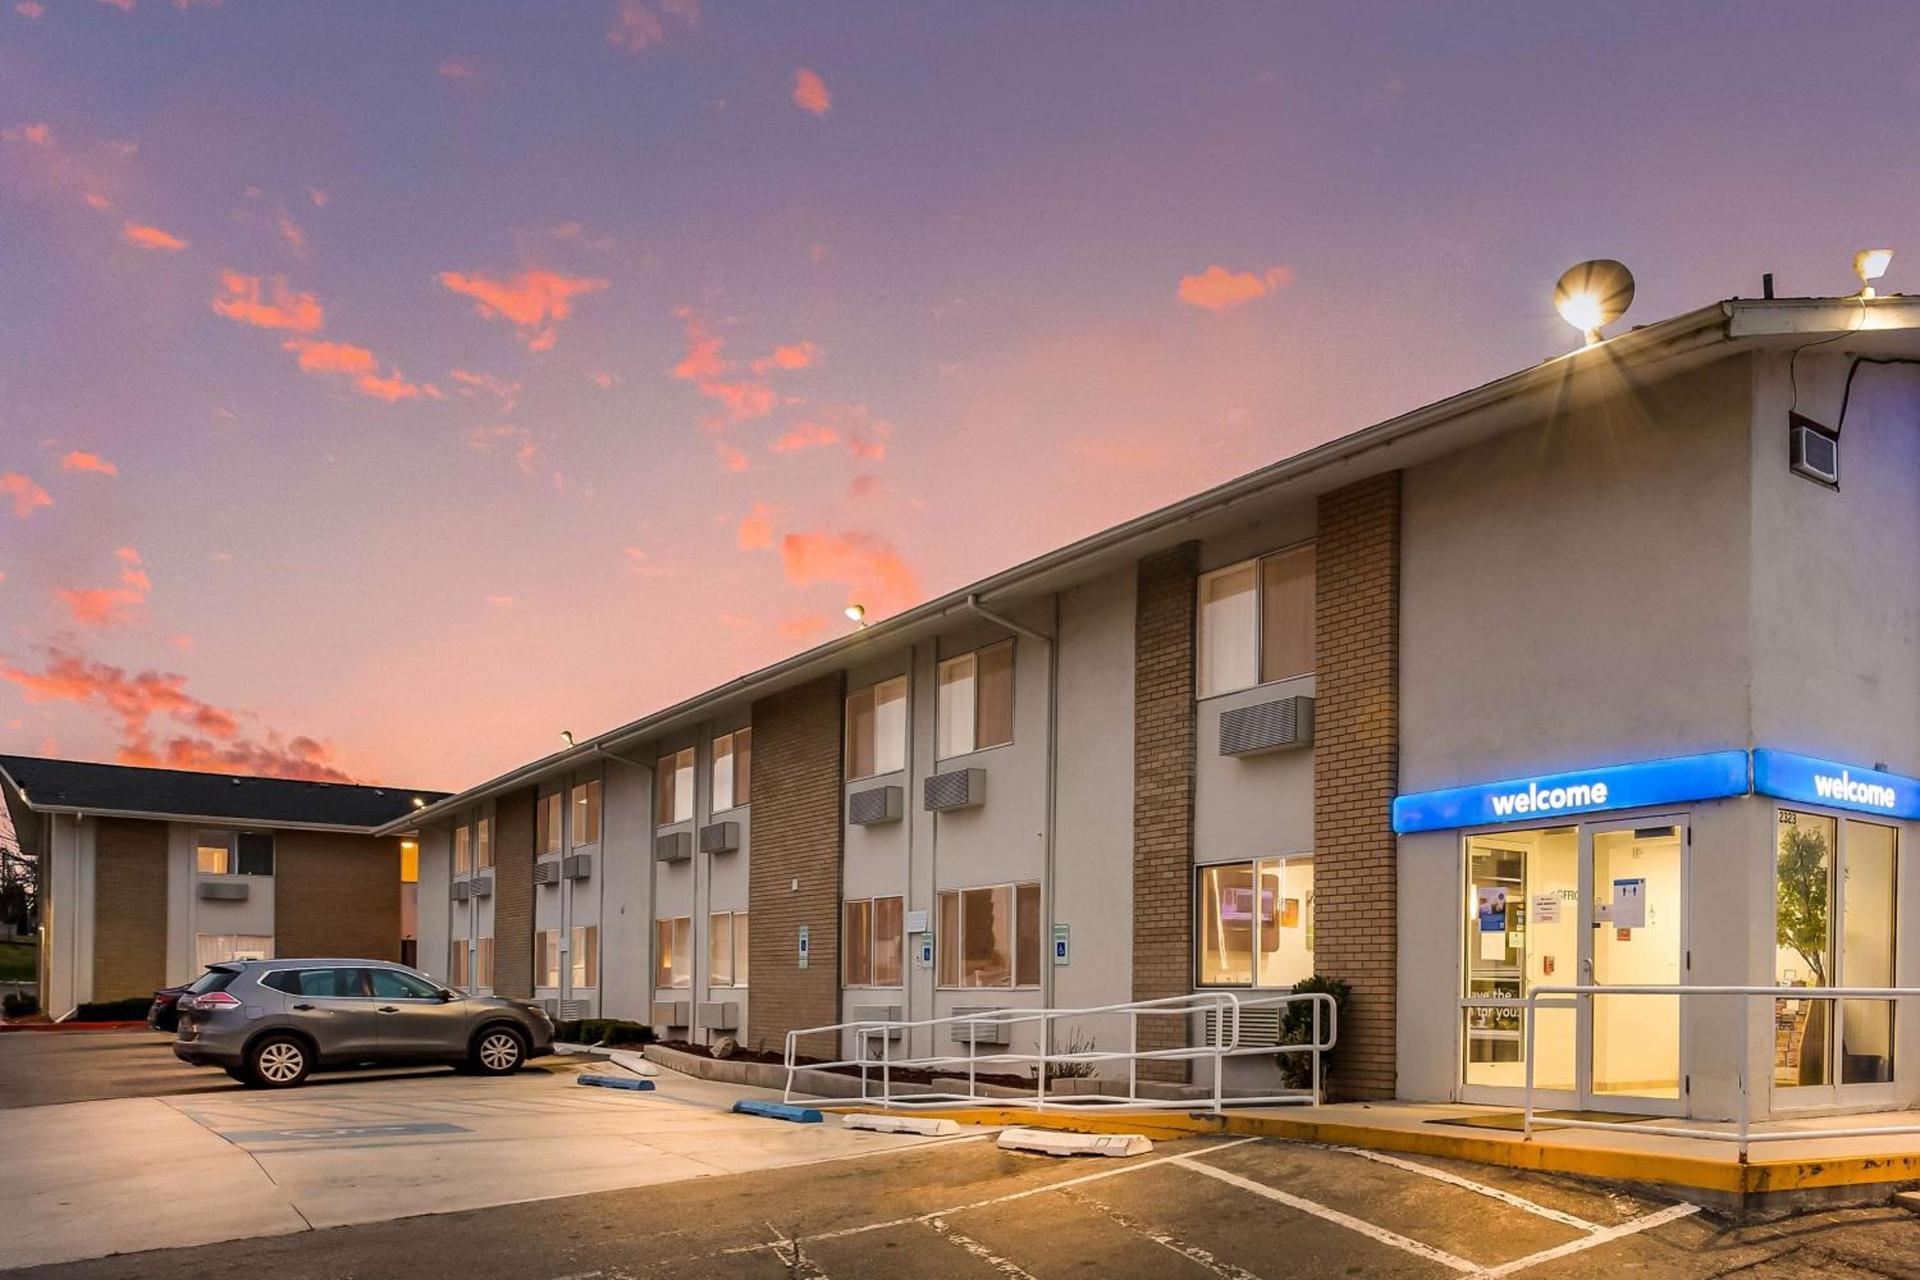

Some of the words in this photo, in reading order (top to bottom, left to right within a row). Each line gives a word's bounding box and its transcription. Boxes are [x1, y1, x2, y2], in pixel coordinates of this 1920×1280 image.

[1814, 770, 1895, 808] welcome
[1492, 782, 1608, 816] welcome
[1779, 811, 1796, 824] 2323
[1493, 988, 1512, 999] the
[1495, 1007, 1520, 1021] you.
